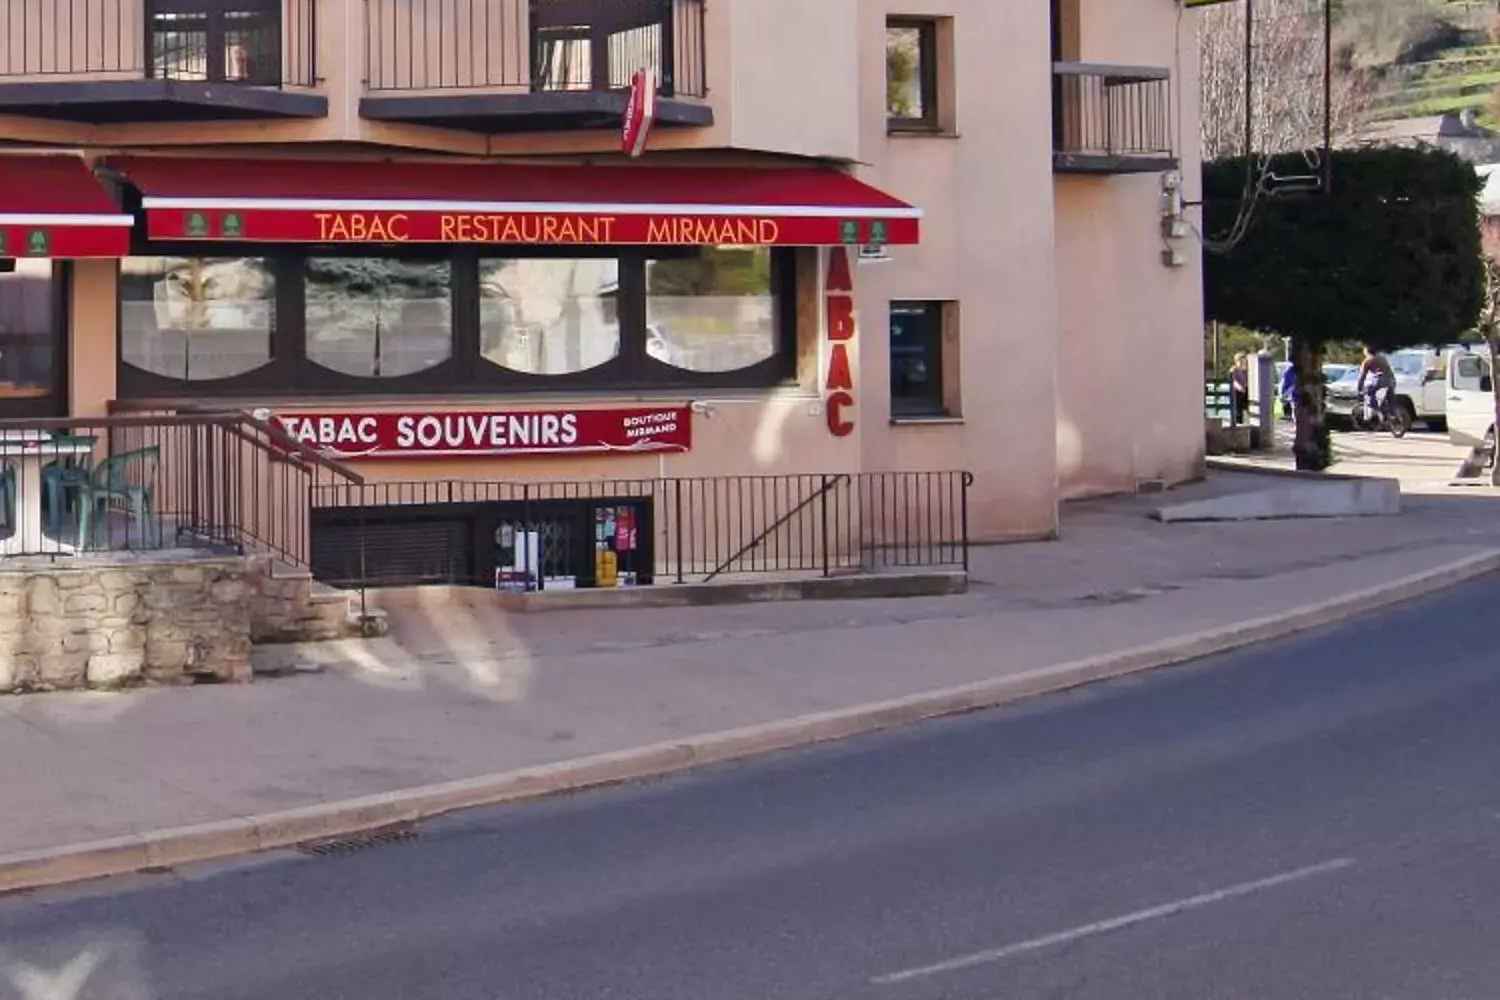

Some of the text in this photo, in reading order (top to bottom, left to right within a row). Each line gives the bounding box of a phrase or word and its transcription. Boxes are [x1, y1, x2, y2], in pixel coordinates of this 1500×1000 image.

[314, 213, 779, 244] TABAC RESTAURANT MIRMAND
[826, 246, 855, 436] ABAC
[283, 413, 577, 447] TABAC SOUVENIRS
[623, 411, 677, 427] BOUTIQUE
[626, 423, 677, 438] MIRMAND
